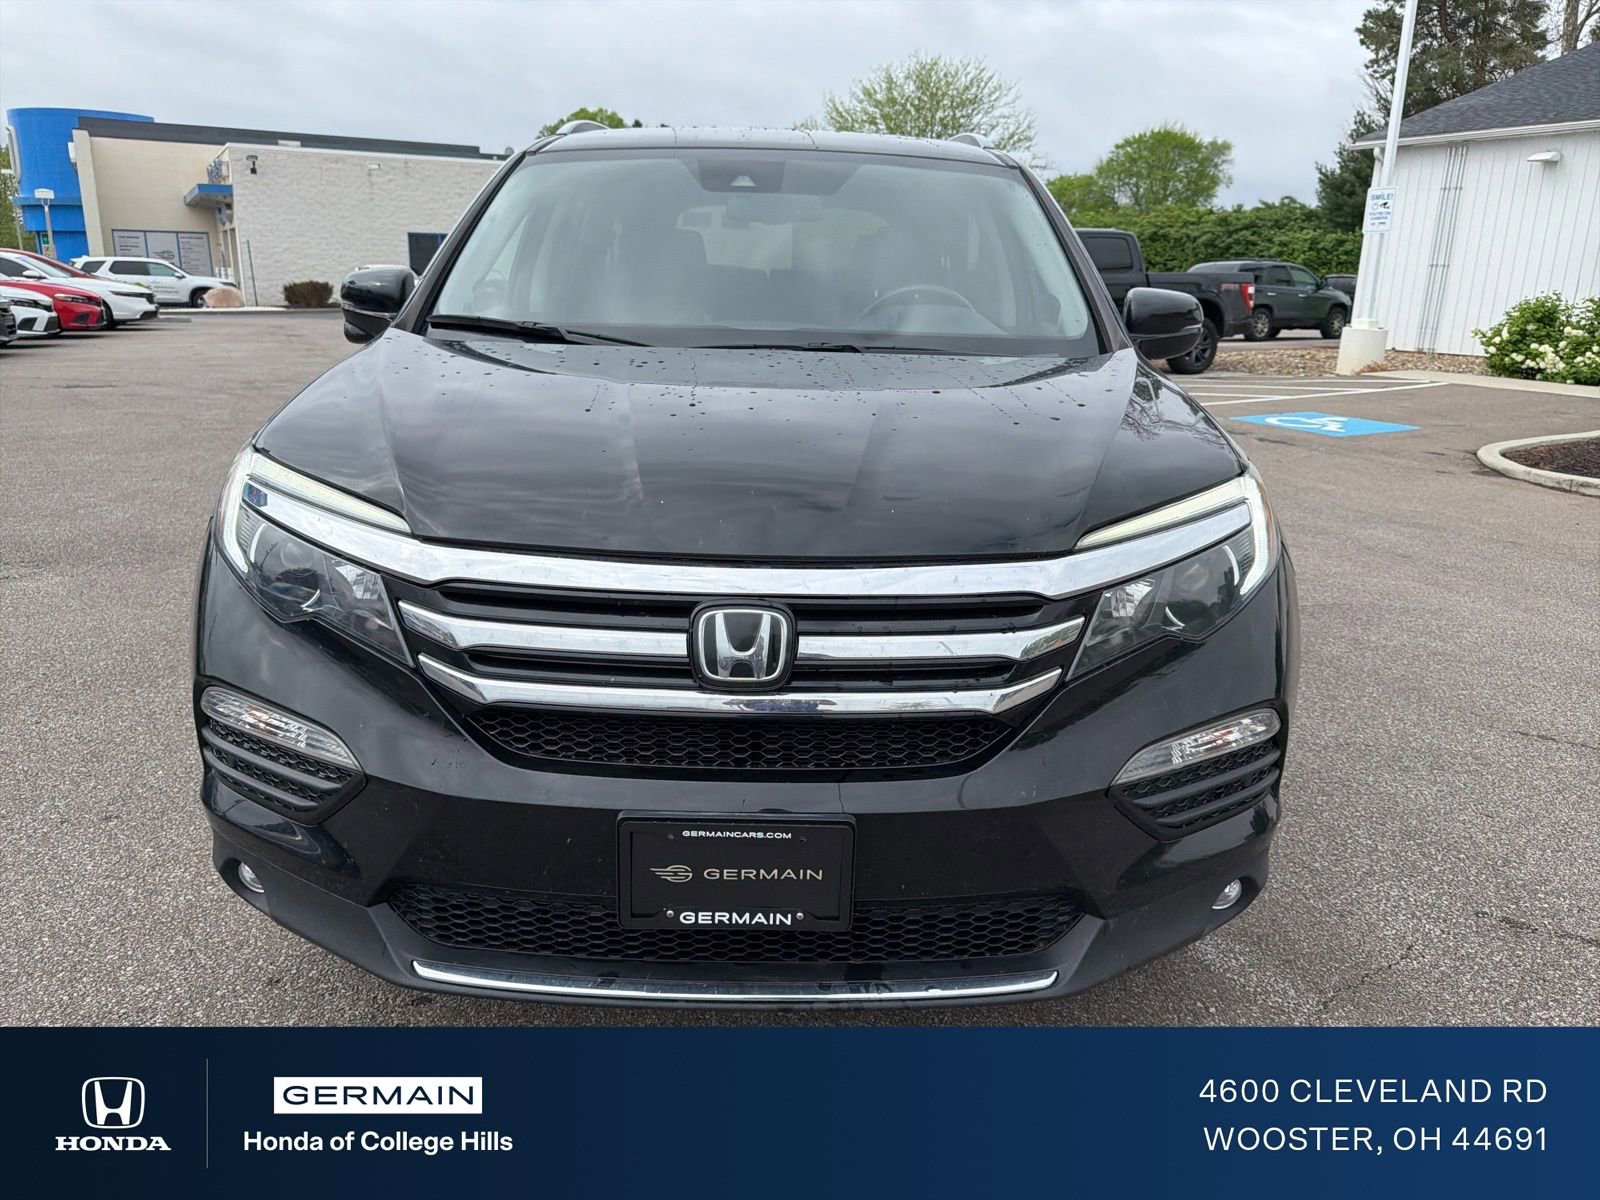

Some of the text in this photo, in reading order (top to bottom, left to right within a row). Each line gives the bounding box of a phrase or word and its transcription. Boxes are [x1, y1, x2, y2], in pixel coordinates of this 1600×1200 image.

[1371, 193, 1394, 201] SMILE!
[682, 830, 792, 839] GERMAINCARS.COM
[703, 868, 823, 881] GERMAIN
[679, 911, 792, 925] GERMAIN
